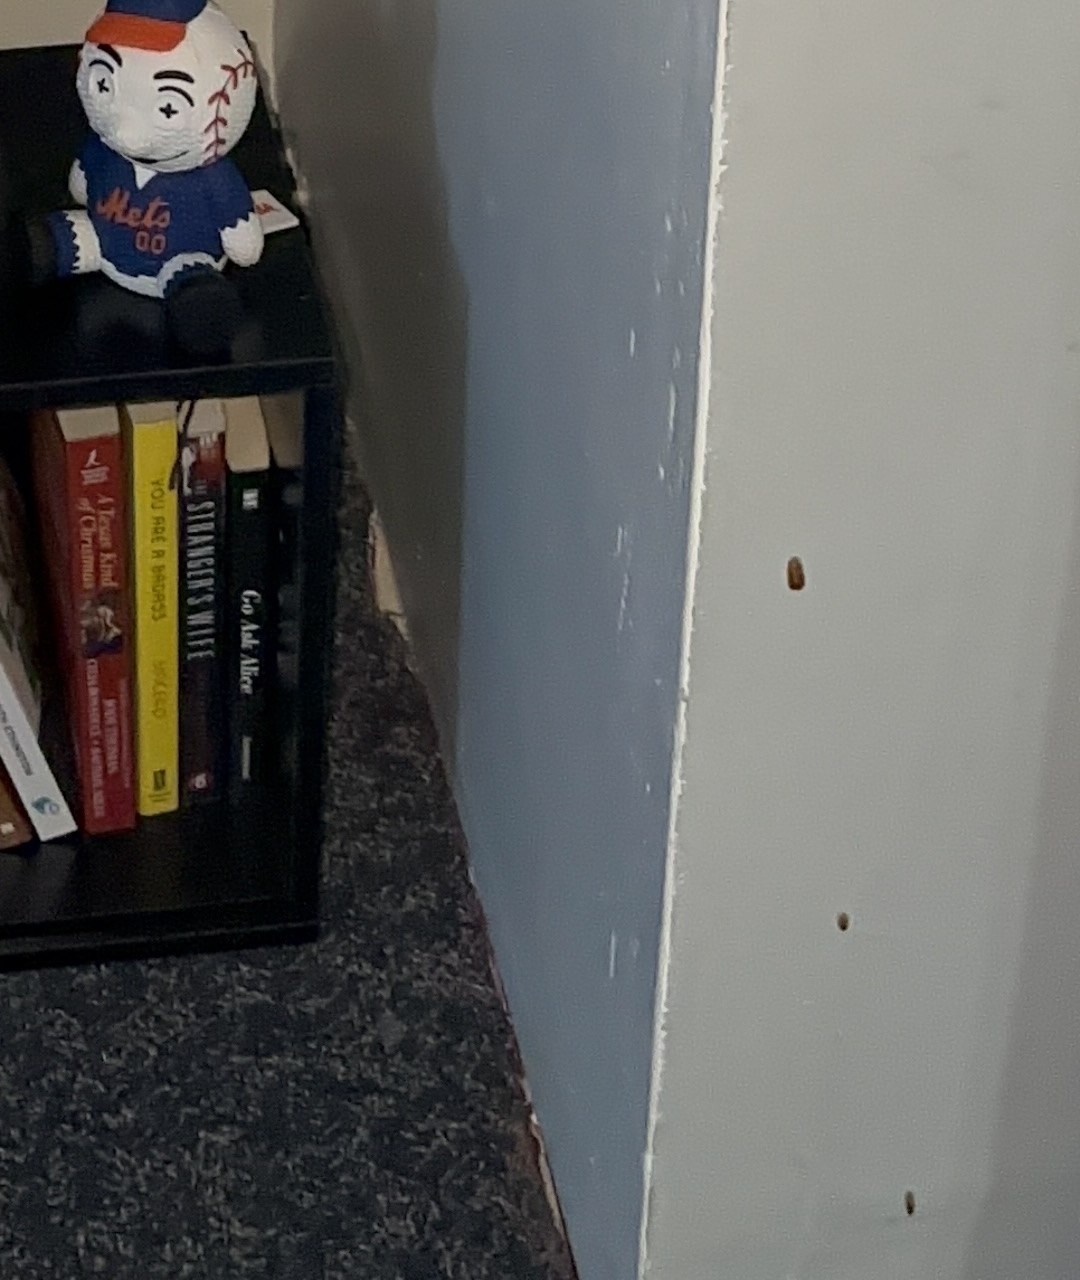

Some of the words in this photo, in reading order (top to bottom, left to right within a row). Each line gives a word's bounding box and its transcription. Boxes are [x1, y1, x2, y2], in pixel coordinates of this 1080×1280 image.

[96, 187, 171, 229] Mets
[135, 230, 167, 255] 00
[150, 476, 165, 510] YOU
[151, 516, 166, 545] ARE
[99, 550, 119, 589] Kind
[151, 548, 166, 560] A
[186, 500, 215, 606] STRANGER'S
[151, 564, 167, 622] BADASS
[240, 589, 262, 615] Go
[186, 609, 215, 660] WIFE
[240, 618, 261, 650] Ask
[239, 652, 260, 695] Alice
